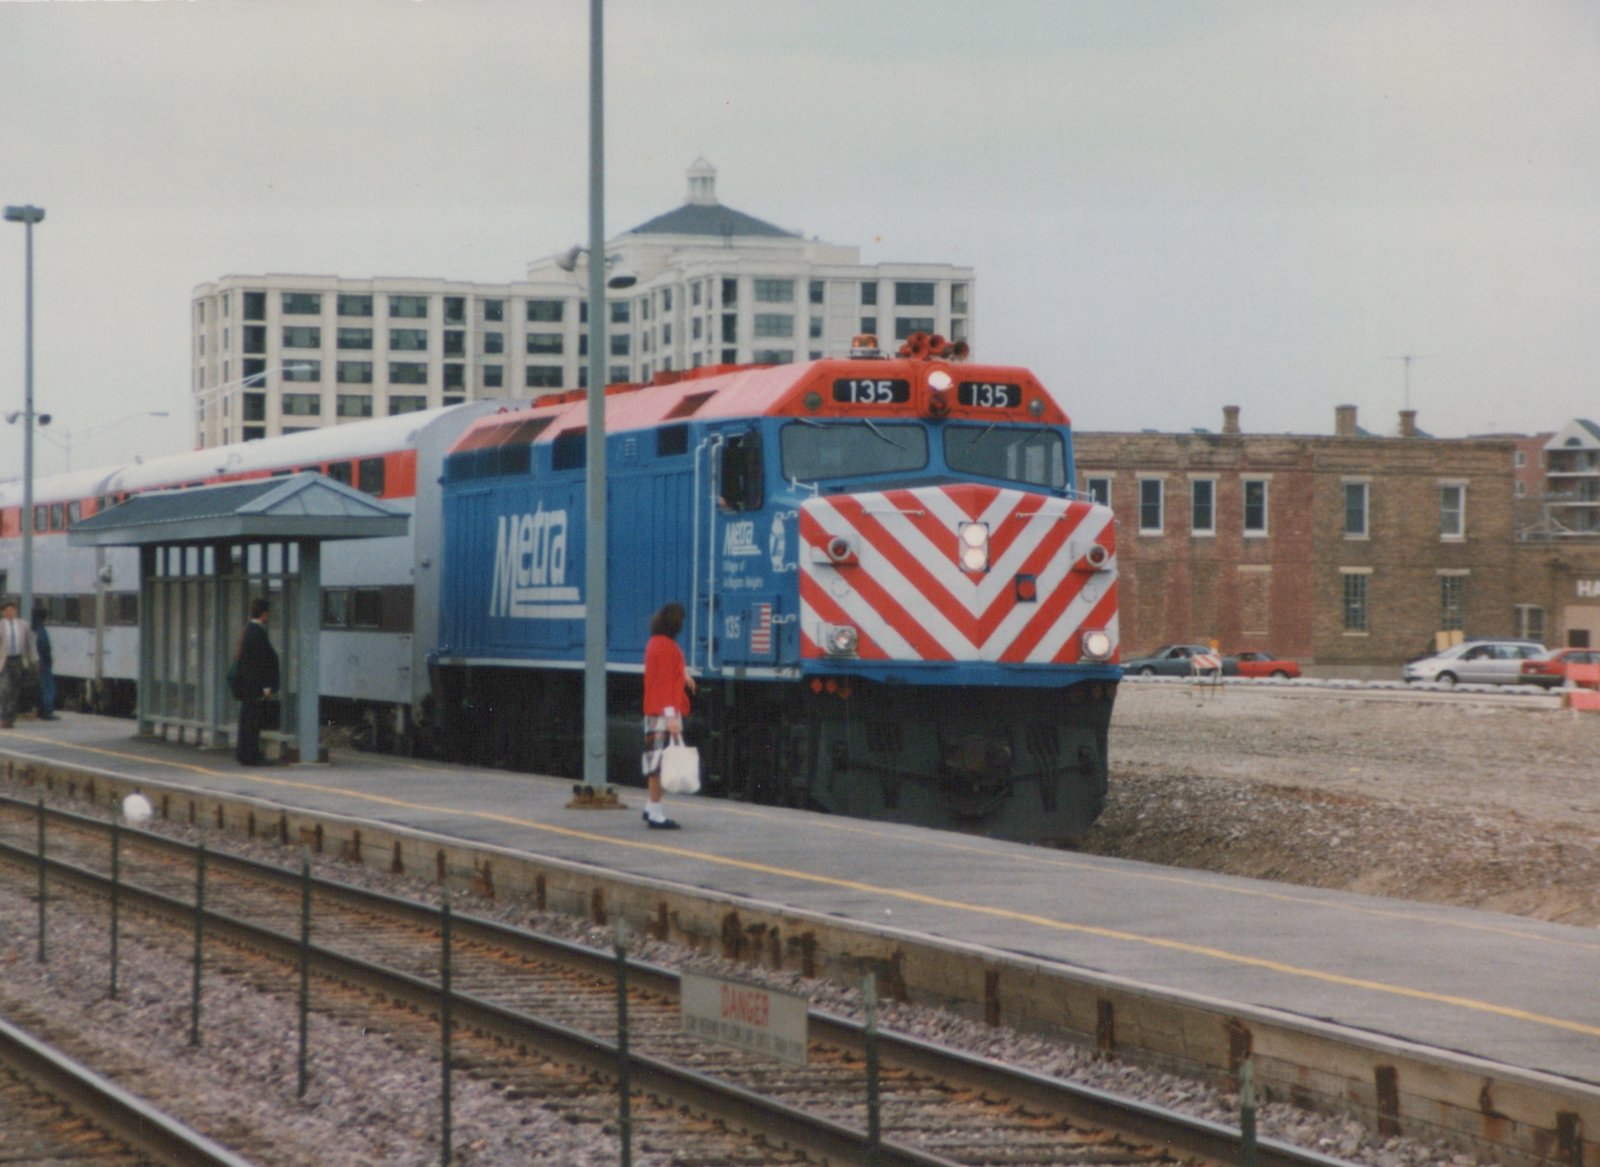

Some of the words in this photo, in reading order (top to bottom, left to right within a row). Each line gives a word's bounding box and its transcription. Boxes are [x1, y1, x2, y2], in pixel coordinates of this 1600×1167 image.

[849, 380, 893, 403] 135
[972, 384, 1008, 407] 135
[489, 500, 569, 618] Metra
[725, 615, 741, 639] 135
[721, 983, 769, 1027] DANGER
